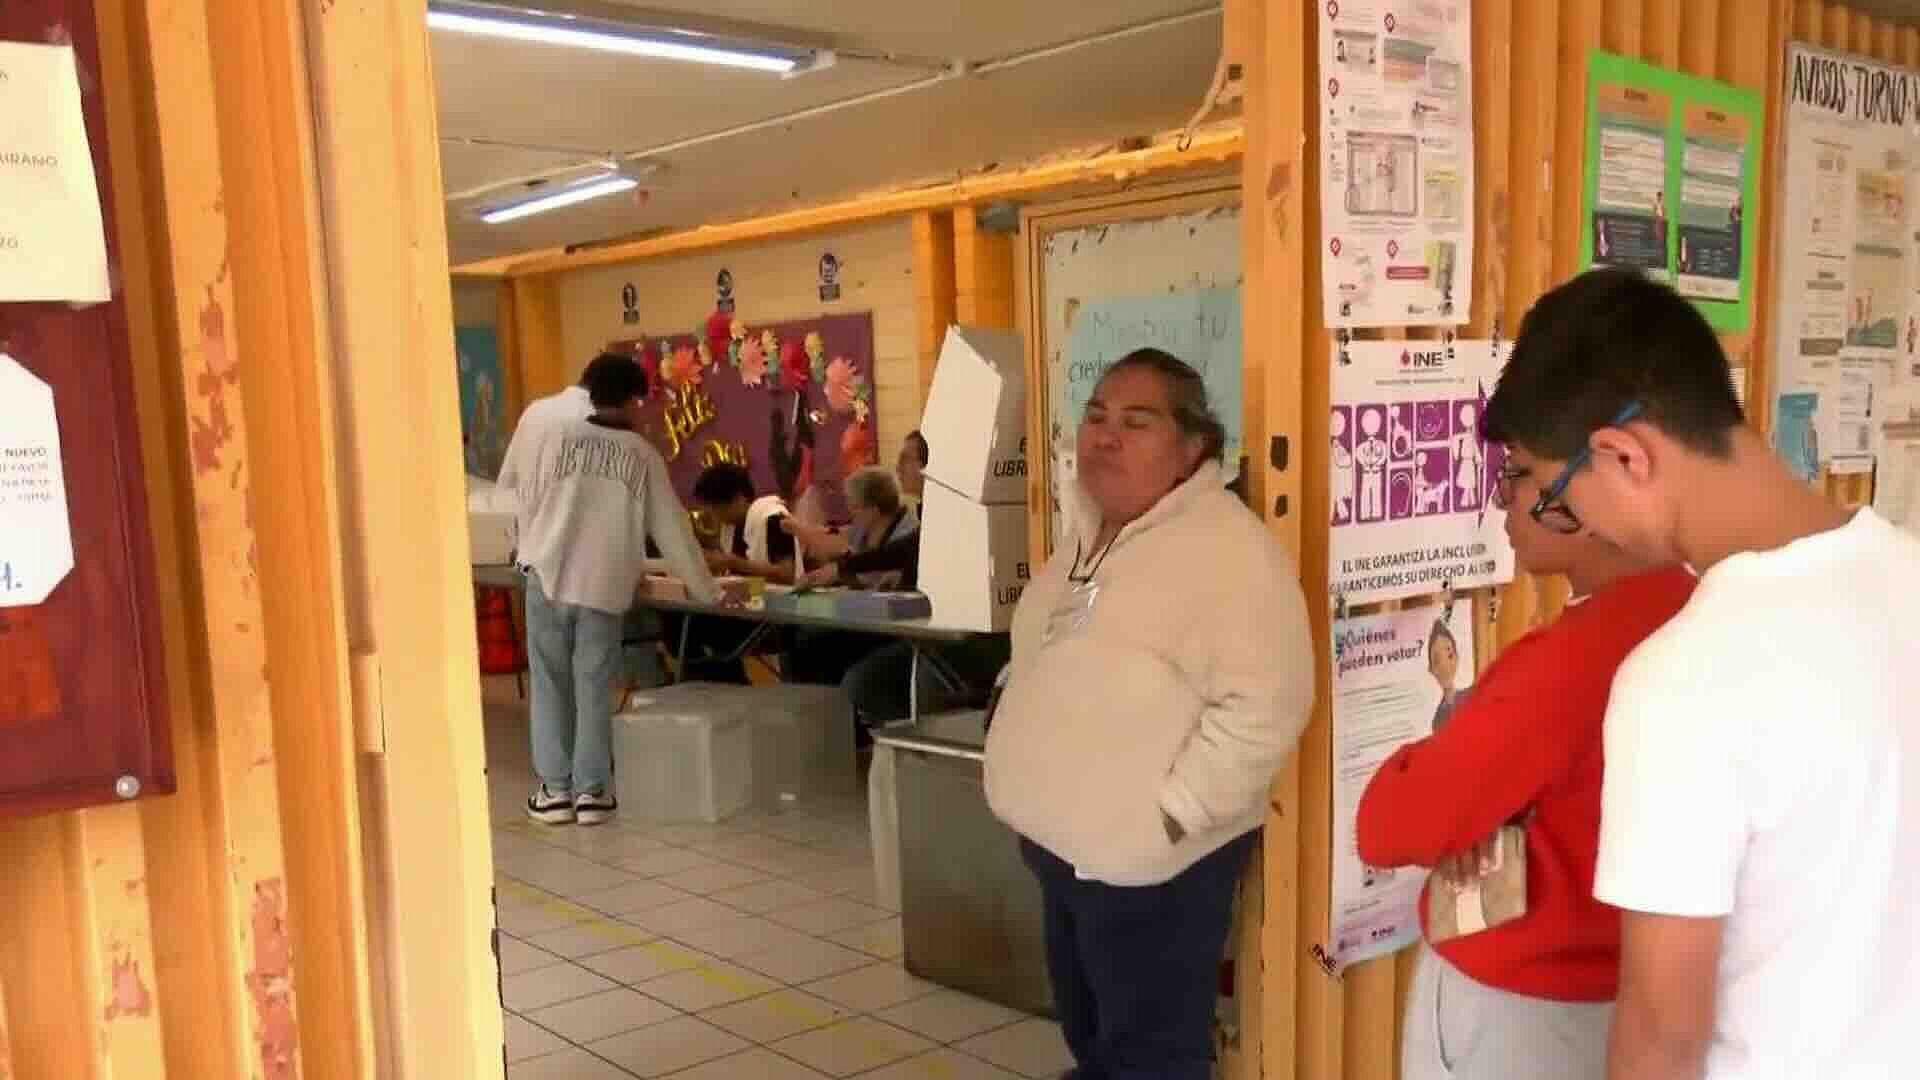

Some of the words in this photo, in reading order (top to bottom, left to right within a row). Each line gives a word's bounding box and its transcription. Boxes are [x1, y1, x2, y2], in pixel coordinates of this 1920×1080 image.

[1792, 54, 1848, 113] AVISOS
[1853, 65, 1906, 126] TURNO
[1414, 352, 1442, 367] INE
[1355, 557, 1371, 571] INE
[1373, 550, 1425, 569] GARANTIZA
[1427, 548, 1440, 561] LA
[1406, 570, 1417, 585] SU
[1339, 650, 1383, 679] pueden
